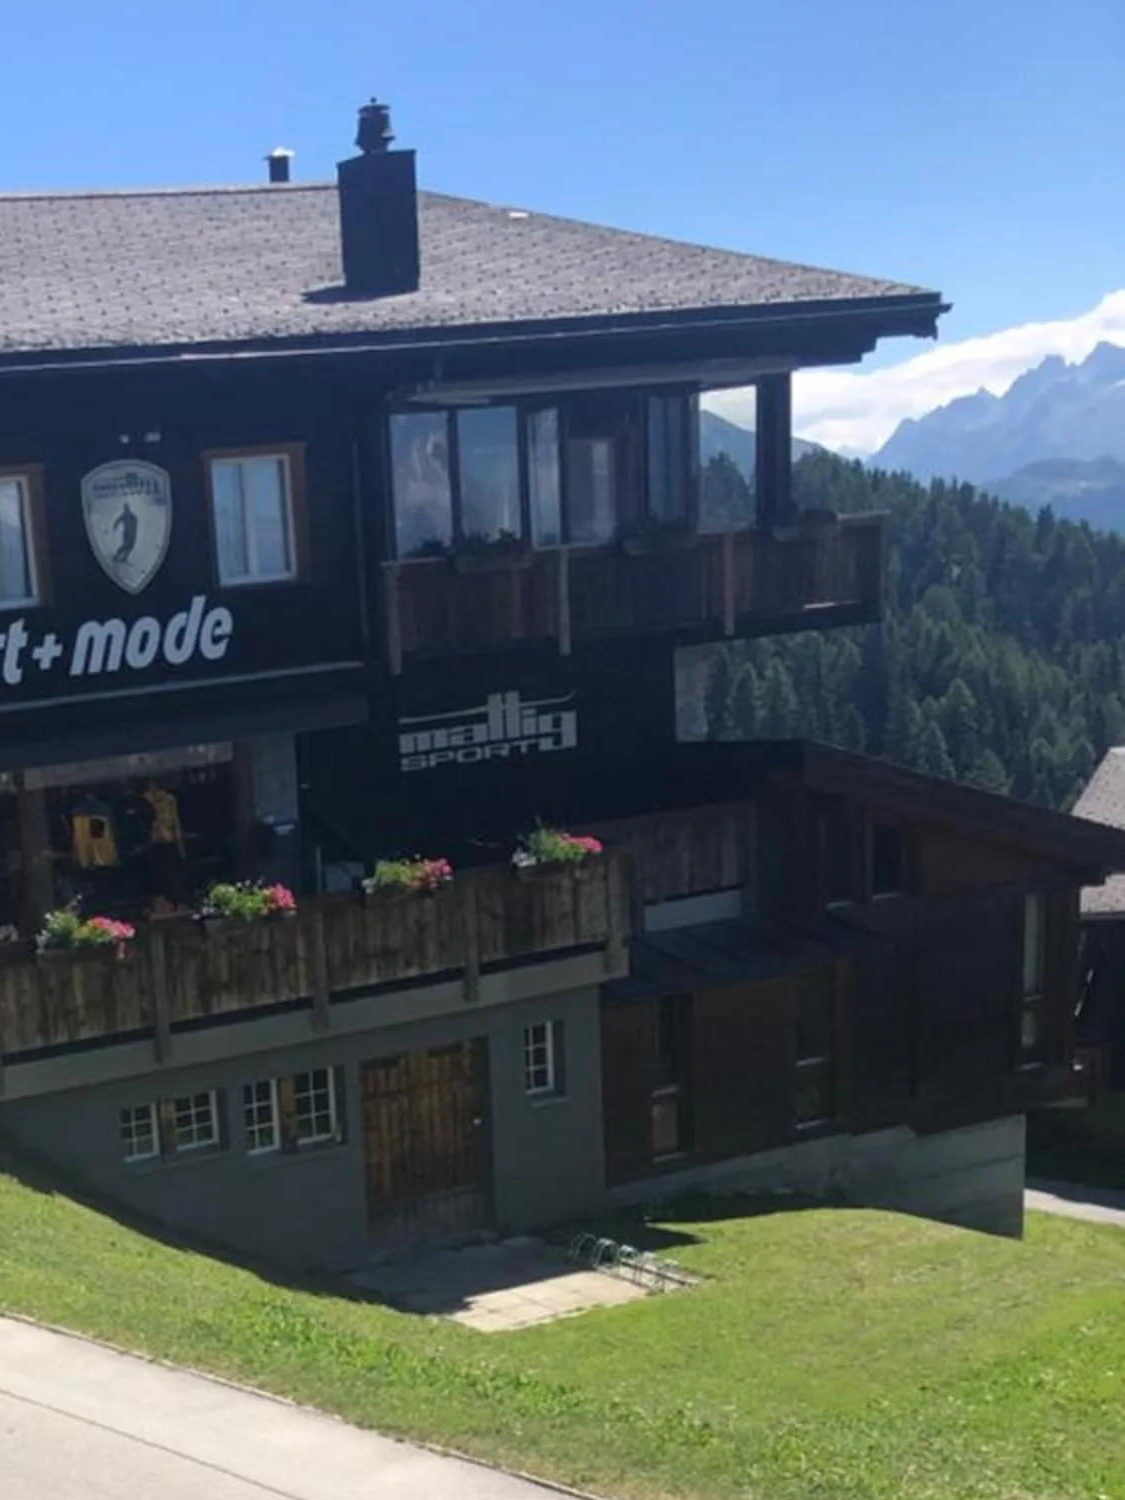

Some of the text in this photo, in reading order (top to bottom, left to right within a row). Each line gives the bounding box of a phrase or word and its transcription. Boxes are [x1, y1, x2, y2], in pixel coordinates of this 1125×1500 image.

[32, 633, 63, 670] +
[69, 595, 234, 676] mode
[398, 691, 577, 754] mattig
[400, 739, 535, 772] SPORT
